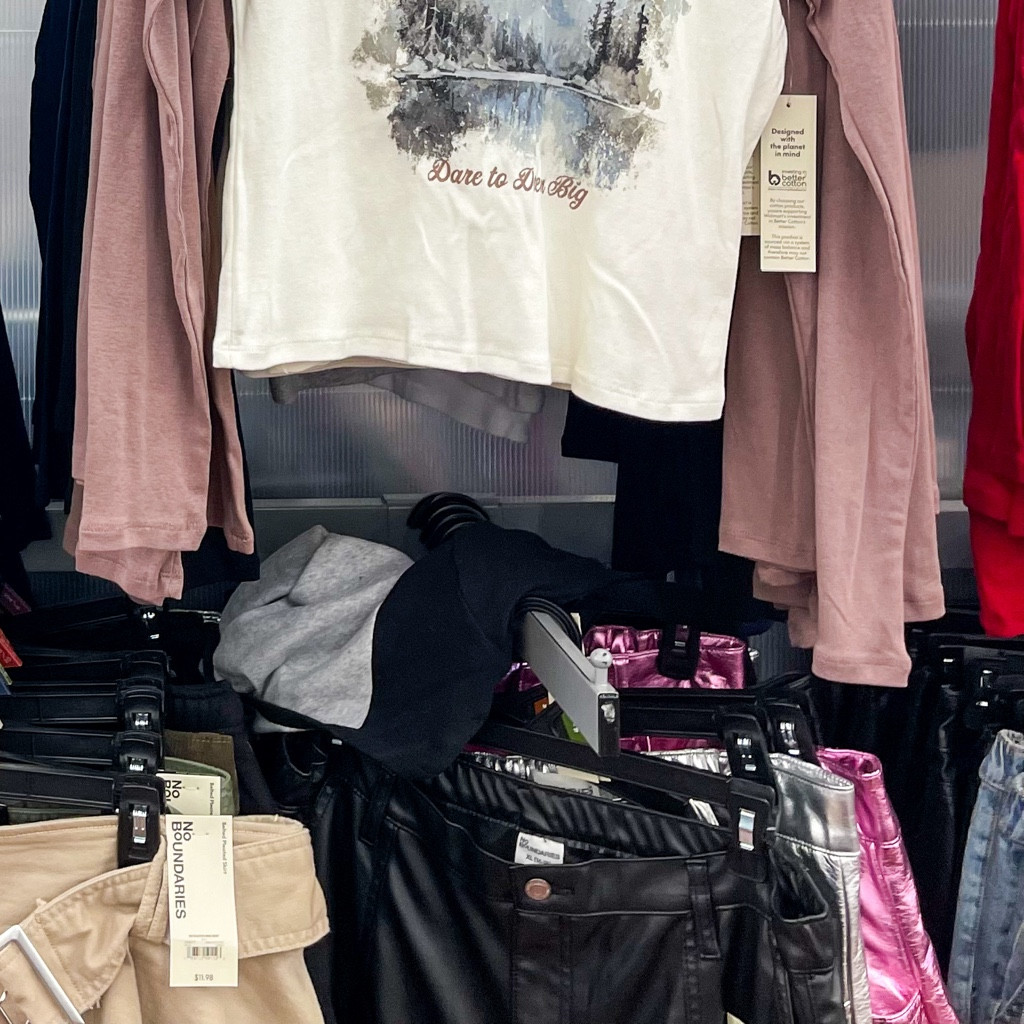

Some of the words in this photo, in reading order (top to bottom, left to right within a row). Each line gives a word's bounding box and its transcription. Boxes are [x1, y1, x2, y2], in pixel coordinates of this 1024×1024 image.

[771, 128, 805, 136] Designed
[427, 157, 483, 187] Dare
[487, 166, 508, 189] to
[547, 175, 589, 210] Big
[172, 780, 182, 798] NO
[183, 821, 193, 842] NO
[171, 821, 187, 919] BOUNDARIES
[194, 973, 214, 981] $11.98
